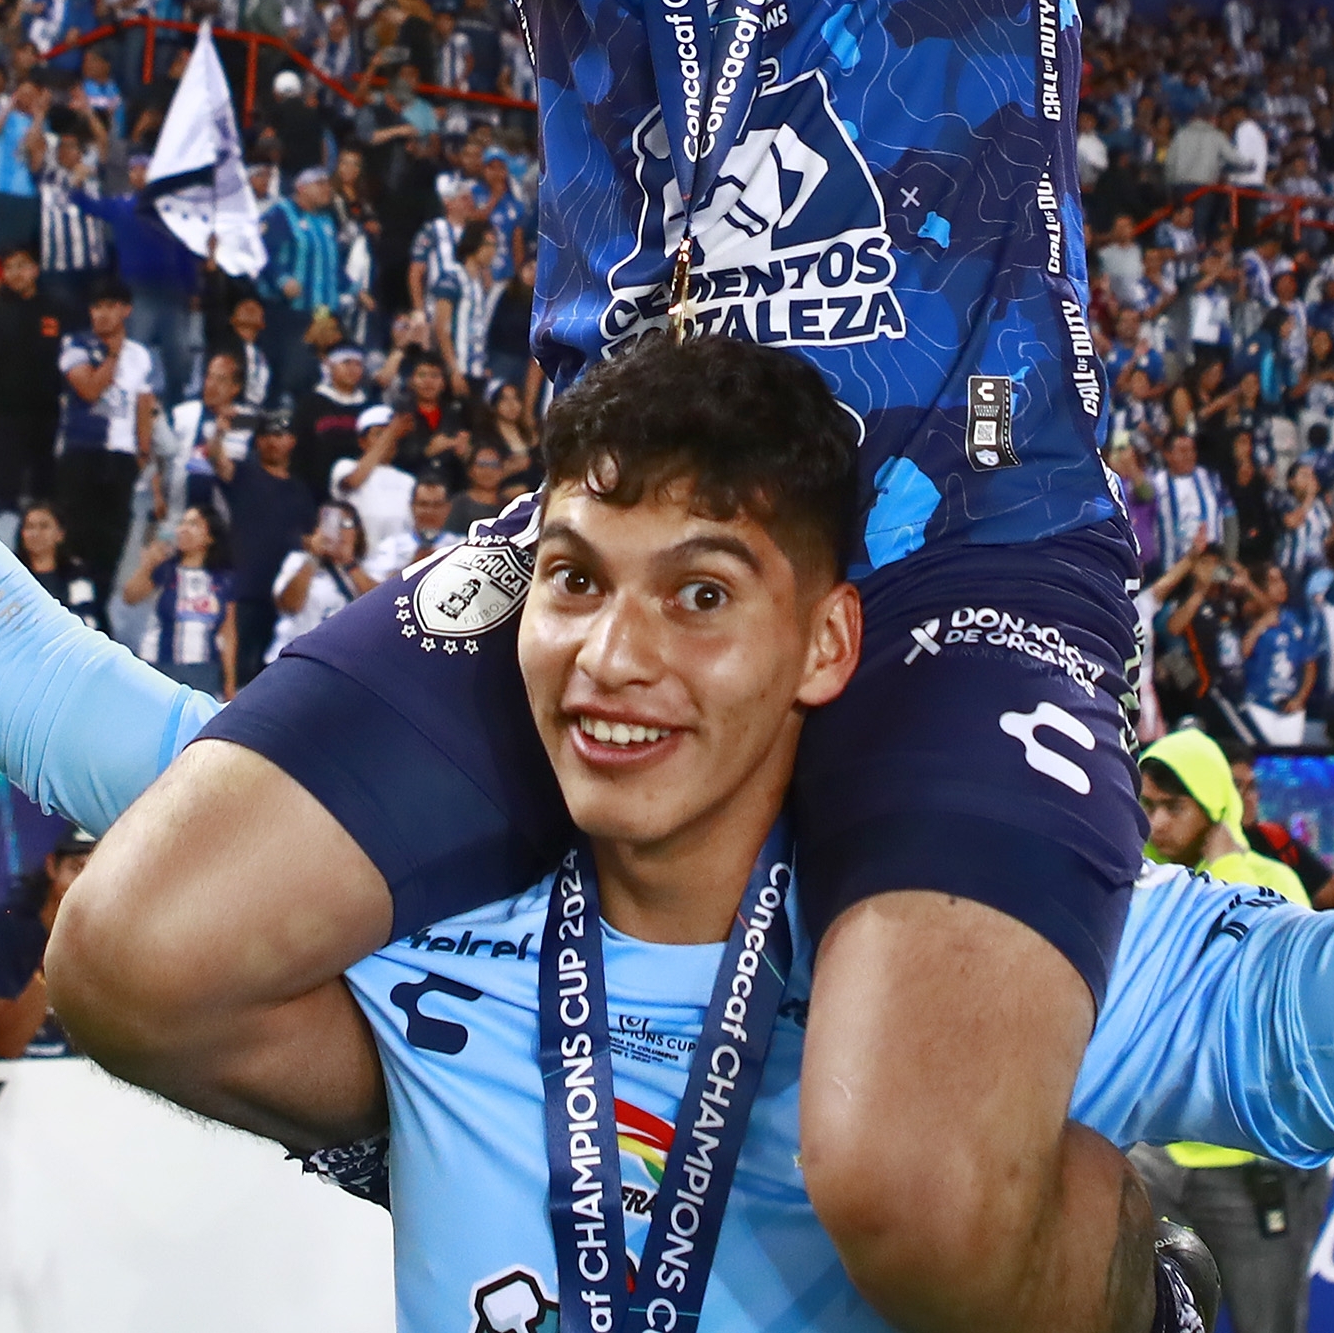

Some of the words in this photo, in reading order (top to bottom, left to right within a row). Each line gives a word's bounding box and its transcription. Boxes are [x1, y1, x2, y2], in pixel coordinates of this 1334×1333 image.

[665, 14, 701, 162] Concacaf
[700, 6, 762, 158] Concacaf
[1044, 58, 1055, 72] OF
[1042, 70, 1062, 121] CALL
[1036, 169, 1056, 211] DU
[1045, 209, 1057, 224] OF
[1047, 223, 1063, 275] CALL
[605, 237, 891, 339] CEMENTOS
[601, 291, 903, 359] TALEZA
[1061, 300, 1095, 357] DUTY
[1076, 355, 1089, 373] OF
[1073, 371, 1099, 417] CALL
[944, 628, 983, 644] DE
[558, 847, 585, 942] 2024
[720, 862, 791, 1043] Concacaf
[558, 947, 590, 1027] CUP
[667, 1038, 697, 1054] CUP
[560, 1033, 608, 1282] CHAMPIONS
[656, 1044, 742, 1294] CHAMPIONS
